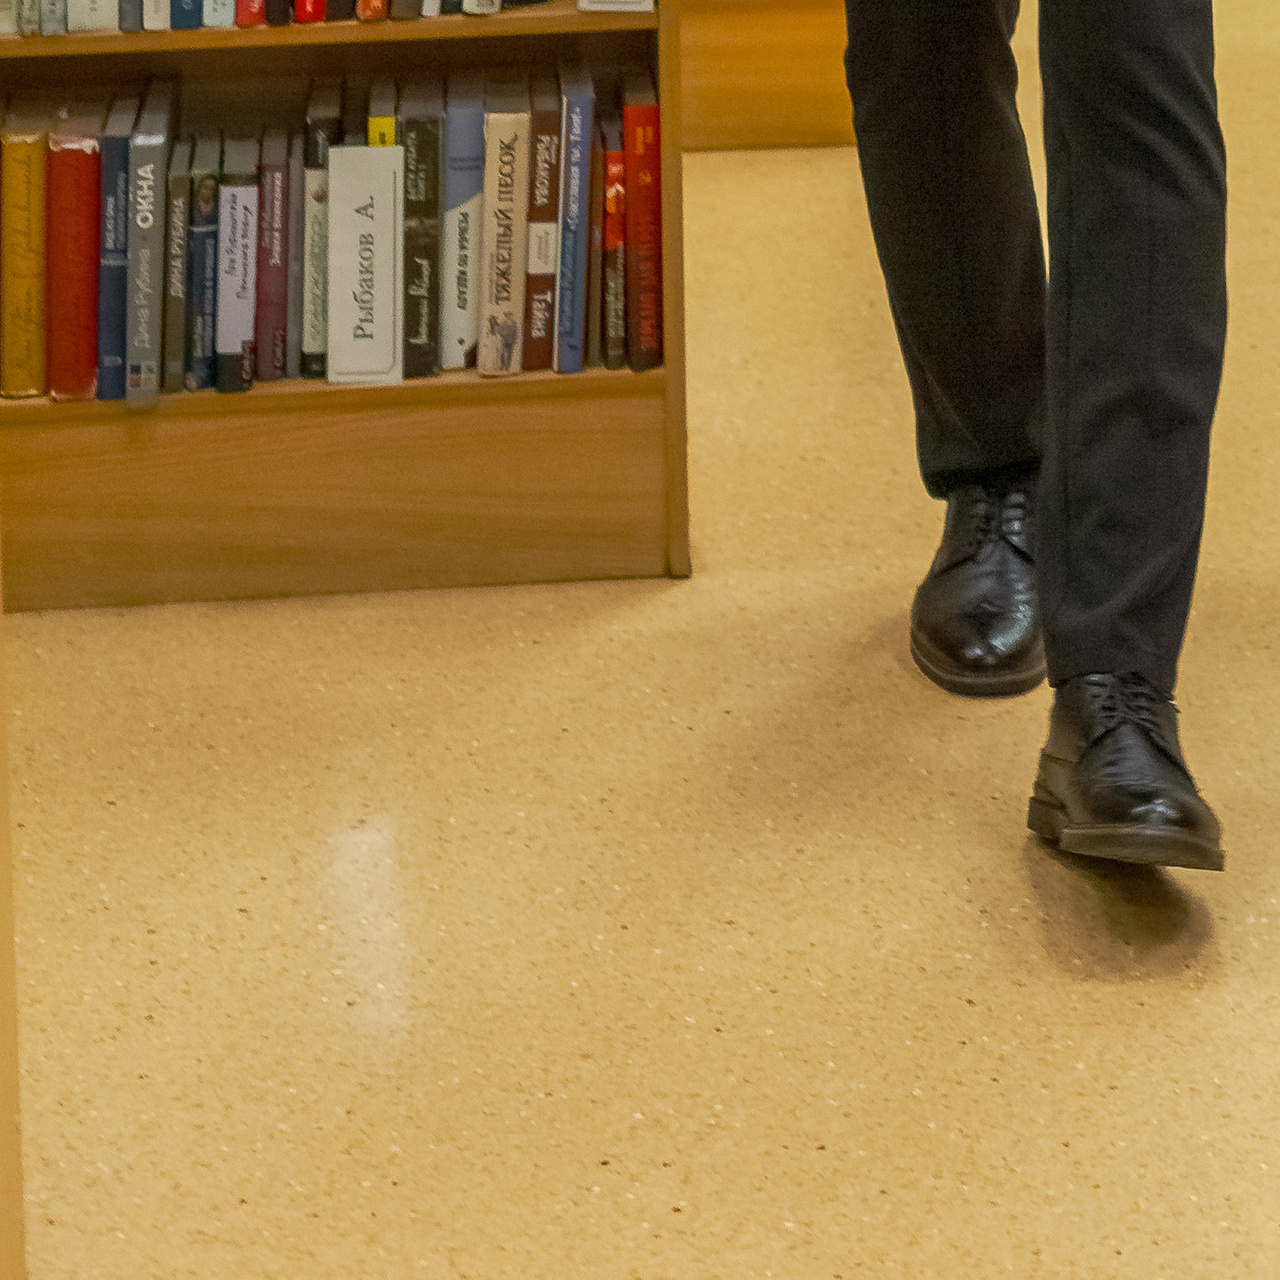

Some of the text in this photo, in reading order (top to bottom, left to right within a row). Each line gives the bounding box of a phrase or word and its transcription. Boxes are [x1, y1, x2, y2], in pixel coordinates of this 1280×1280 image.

[134, 162, 156, 349] Дина Рубина ОКНА
[170, 197, 185, 298] ДИНА РУБИНА
[352, 195, 374, 341] Рыбаков А.
[491, 132, 518, 305] ТЯЖЕЛЫЙ ПЕСОК
[455, 269, 468, 310] ИДЕАЛУ
[530, 290, 551, 338] Тайна
